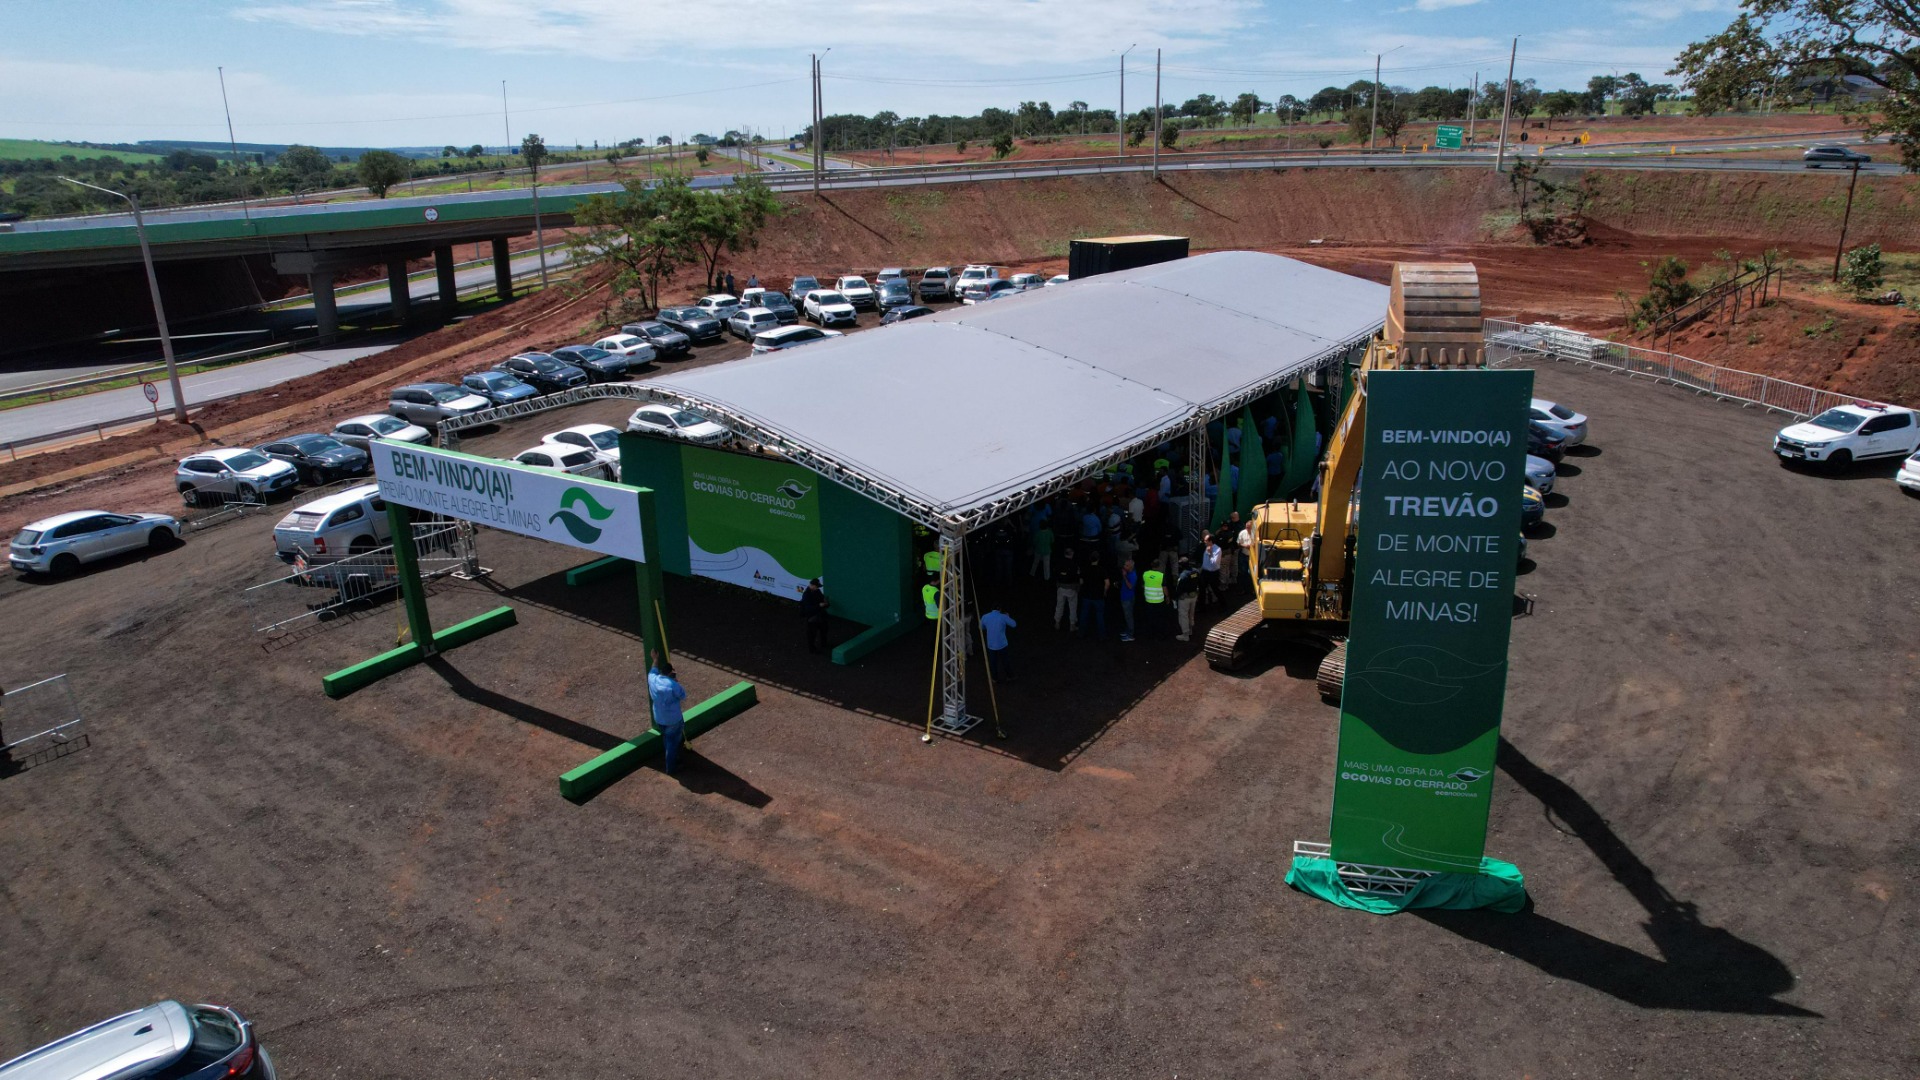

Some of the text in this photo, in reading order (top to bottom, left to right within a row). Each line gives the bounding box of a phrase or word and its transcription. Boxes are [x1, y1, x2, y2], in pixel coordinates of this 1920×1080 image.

[1382, 430, 1511, 447] BEM-VINDO(A)
[391, 451, 514, 505] BEM-VINDO(A)!
[1381, 460, 1506, 481] AO NOVO
[378, 480, 542, 532] TREVÃO MONTE ALEGRE DE MINAS
[735, 488, 748, 500] DO
[750, 492, 796, 510] CERRADO
[1384, 492, 1499, 517] TREVÃO
[1378, 533, 1500, 554] DE MONTE
[1370, 569, 1499, 589] ALEGRE DE
[1385, 600, 1478, 623] MINAS!
[1343, 760, 1444, 777] MAIS UMA OBRA DA
[1341, 771, 1468, 791] ecoVIAS DO CERRADO
